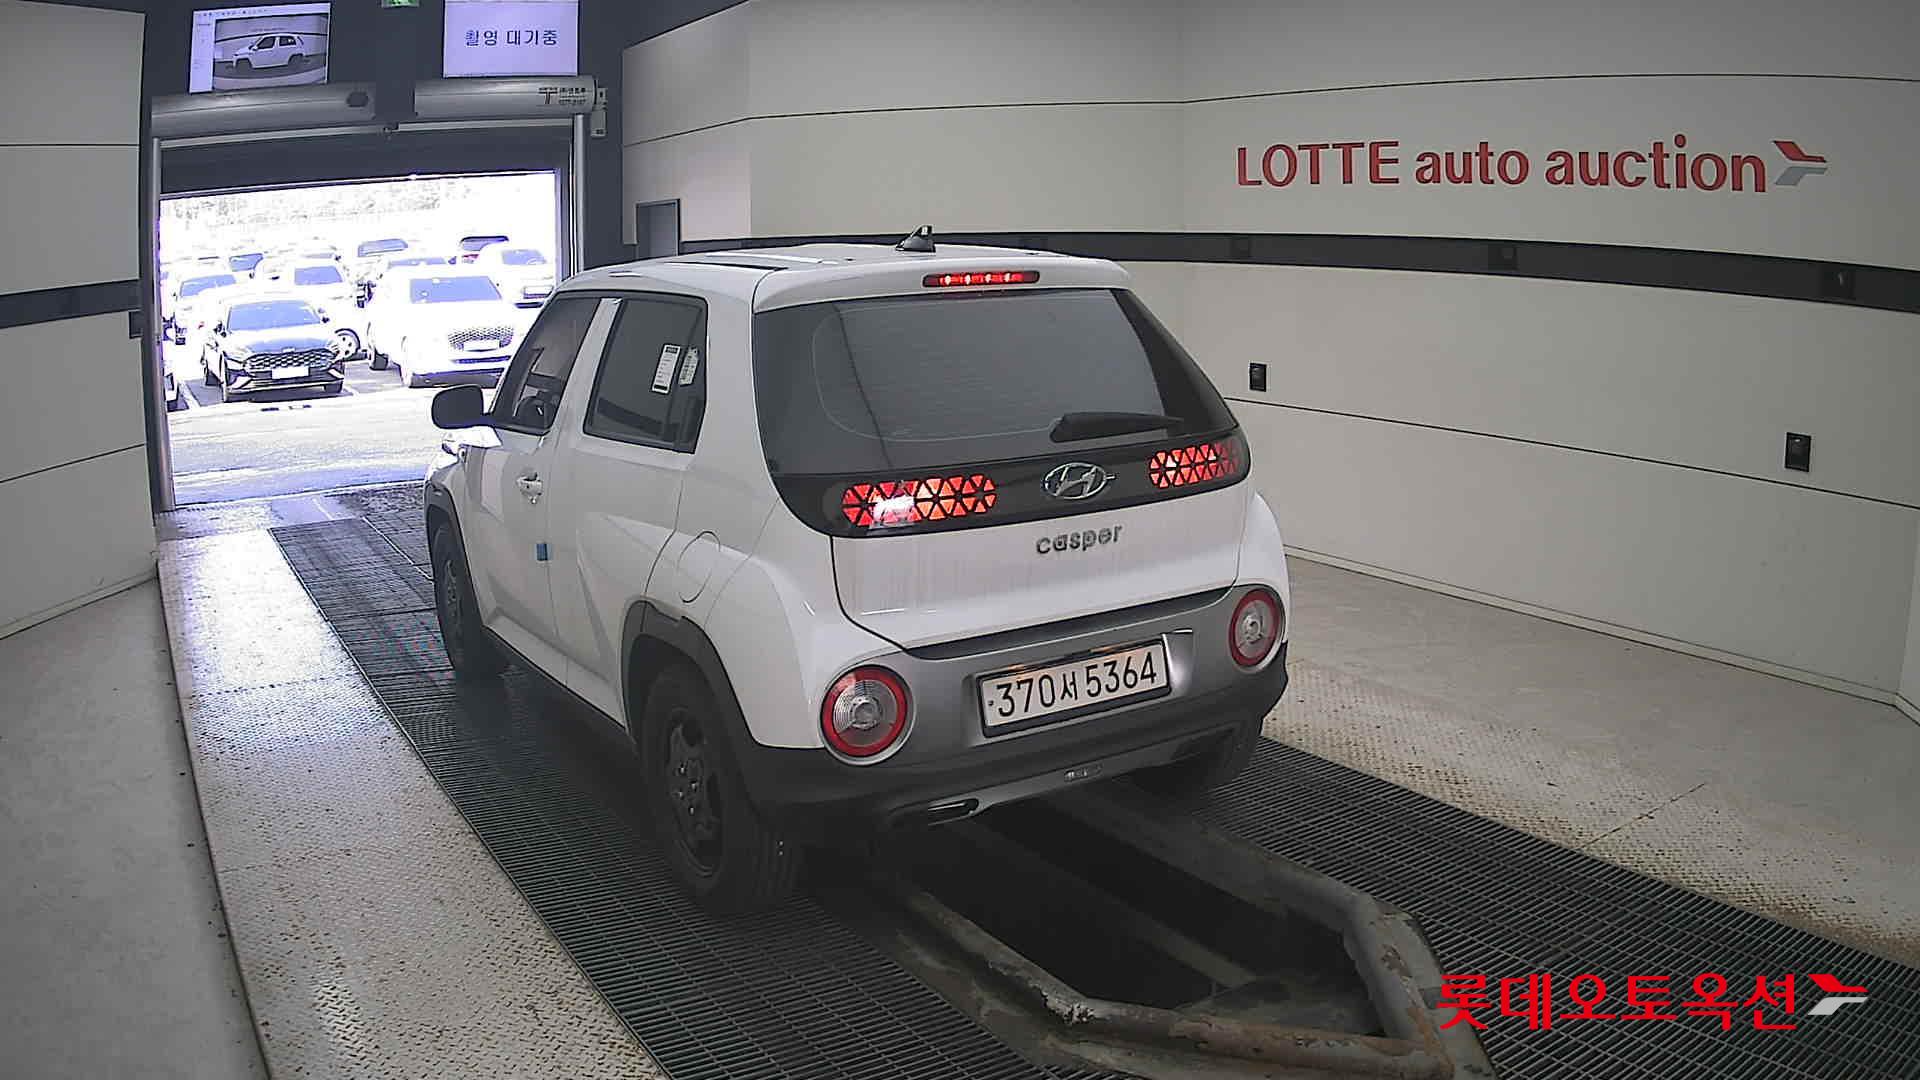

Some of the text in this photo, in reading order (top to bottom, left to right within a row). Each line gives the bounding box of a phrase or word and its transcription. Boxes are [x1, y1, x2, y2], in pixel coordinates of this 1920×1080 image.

[506, 30, 558, 46] 대기중
[1237, 133, 1766, 193] LOTTE auto auction
[1036, 525, 1122, 554] casper
